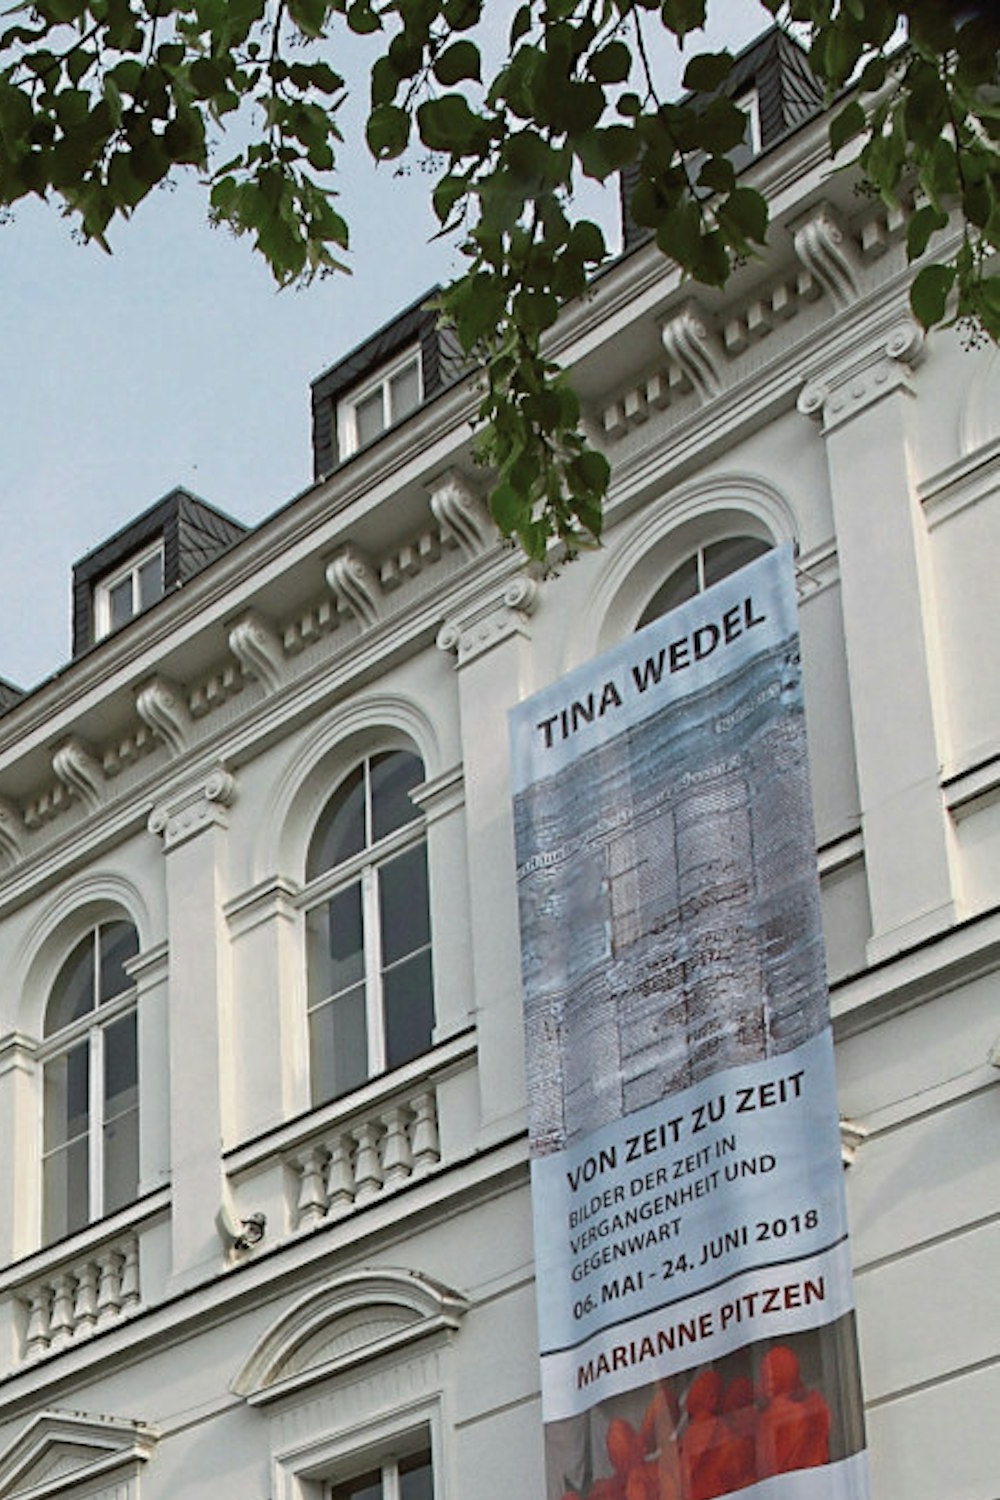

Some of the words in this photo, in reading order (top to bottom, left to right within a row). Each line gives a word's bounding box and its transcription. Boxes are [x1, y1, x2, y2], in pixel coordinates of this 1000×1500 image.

[536, 682, 623, 748] TINA
[632, 597, 766, 693] WEDEL
[566, 1146, 618, 1193] VON
[625, 1118, 684, 1162] ZEIT
[691, 1096, 726, 1134] ZU
[736, 1071, 805, 1113] ZEIT
[568, 1186, 625, 1228] BILDER
[630, 1168, 668, 1198] DER
[673, 1146, 712, 1179] ZEIT
[716, 1135, 736, 1158] IN
[569, 1170, 720, 1255] VERGANGENHEIT
[726, 1154, 776, 1182] UND
[571, 1218, 682, 1282] GEGENWART
[572, 1292, 598, 1319] 06.
[602, 1271, 644, 1304] MAI
[662, 1256, 695, 1279] 24.
[700, 1226, 749, 1267] JUNI
[756, 1209, 819, 1242] 2018
[577, 1313, 714, 1389] MARIANNE
[720, 1277, 826, 1330] PITZEN
